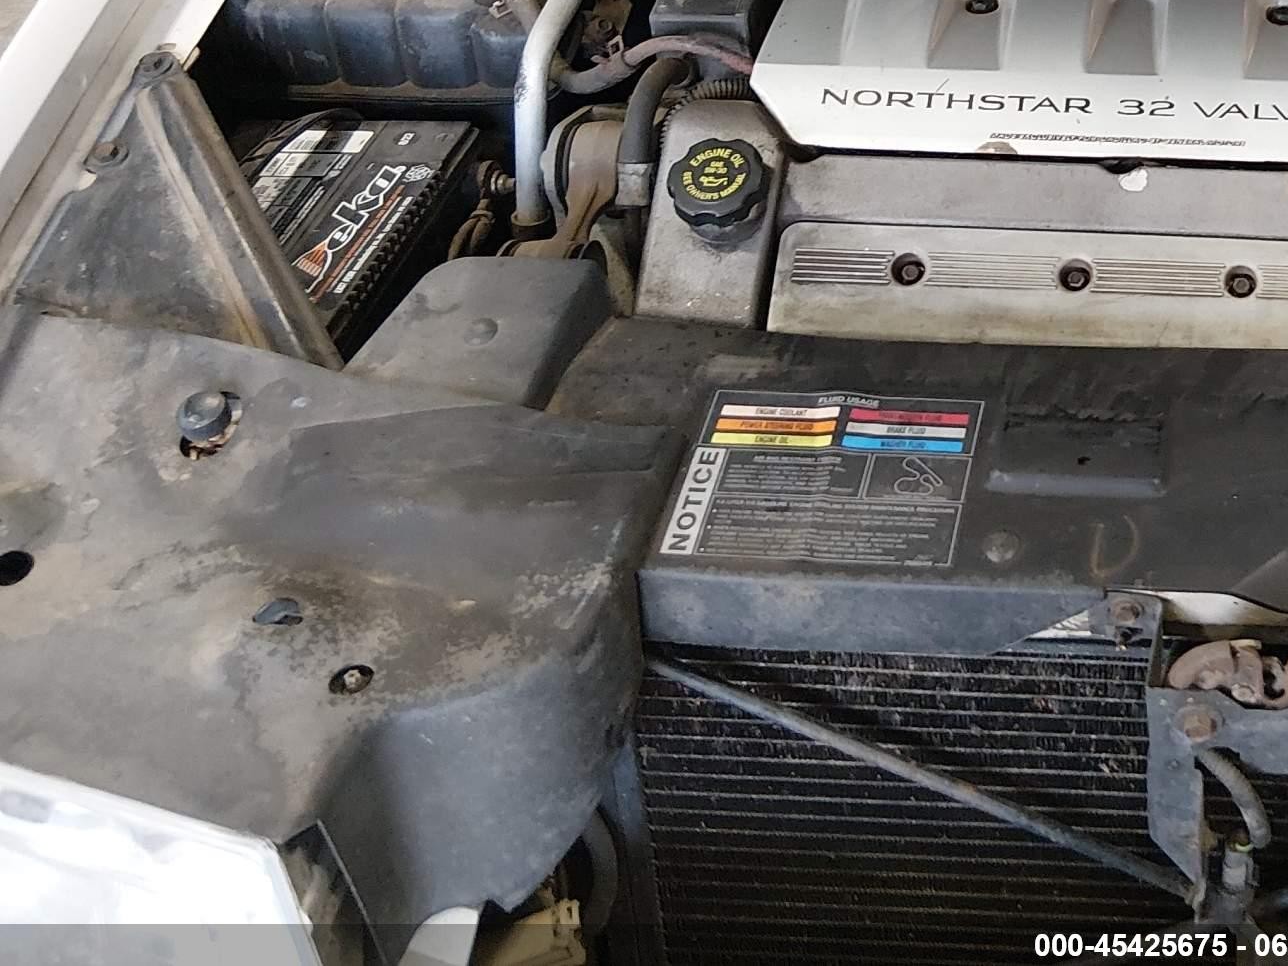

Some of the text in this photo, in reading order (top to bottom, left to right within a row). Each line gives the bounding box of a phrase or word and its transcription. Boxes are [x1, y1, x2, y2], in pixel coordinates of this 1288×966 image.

[821, 87, 1093, 114] NORTHSTAR
[1116, 97, 1176, 117] 32
[690, 148, 745, 168] ENGINE OIL
[818, 395, 848, 405] FLUID
[668, 450, 720, 551] NOTICE
